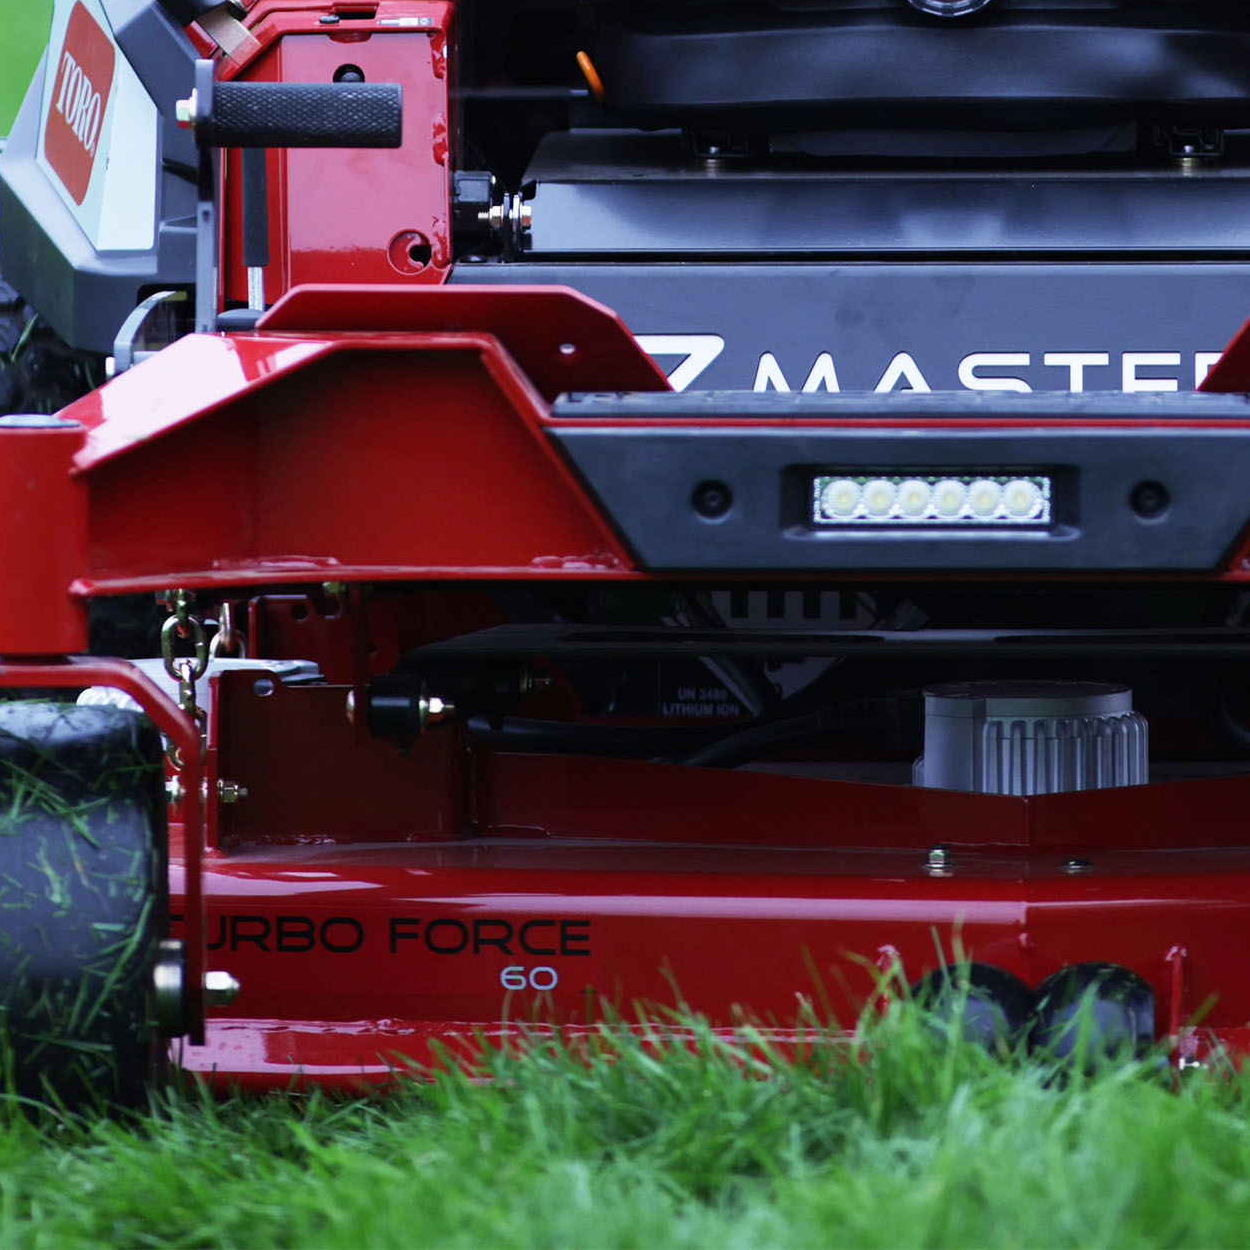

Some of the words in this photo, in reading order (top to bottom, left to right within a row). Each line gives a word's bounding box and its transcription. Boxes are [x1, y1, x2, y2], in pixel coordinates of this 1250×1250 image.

[56, 50, 101, 152] TORO
[752, 351, 1225, 393] MASTE
[662, 702, 713, 717] LITHIUM
[716, 702, 739, 717] ION
[390, 918, 592, 956] FORCE
[500, 966, 558, 990] 60
